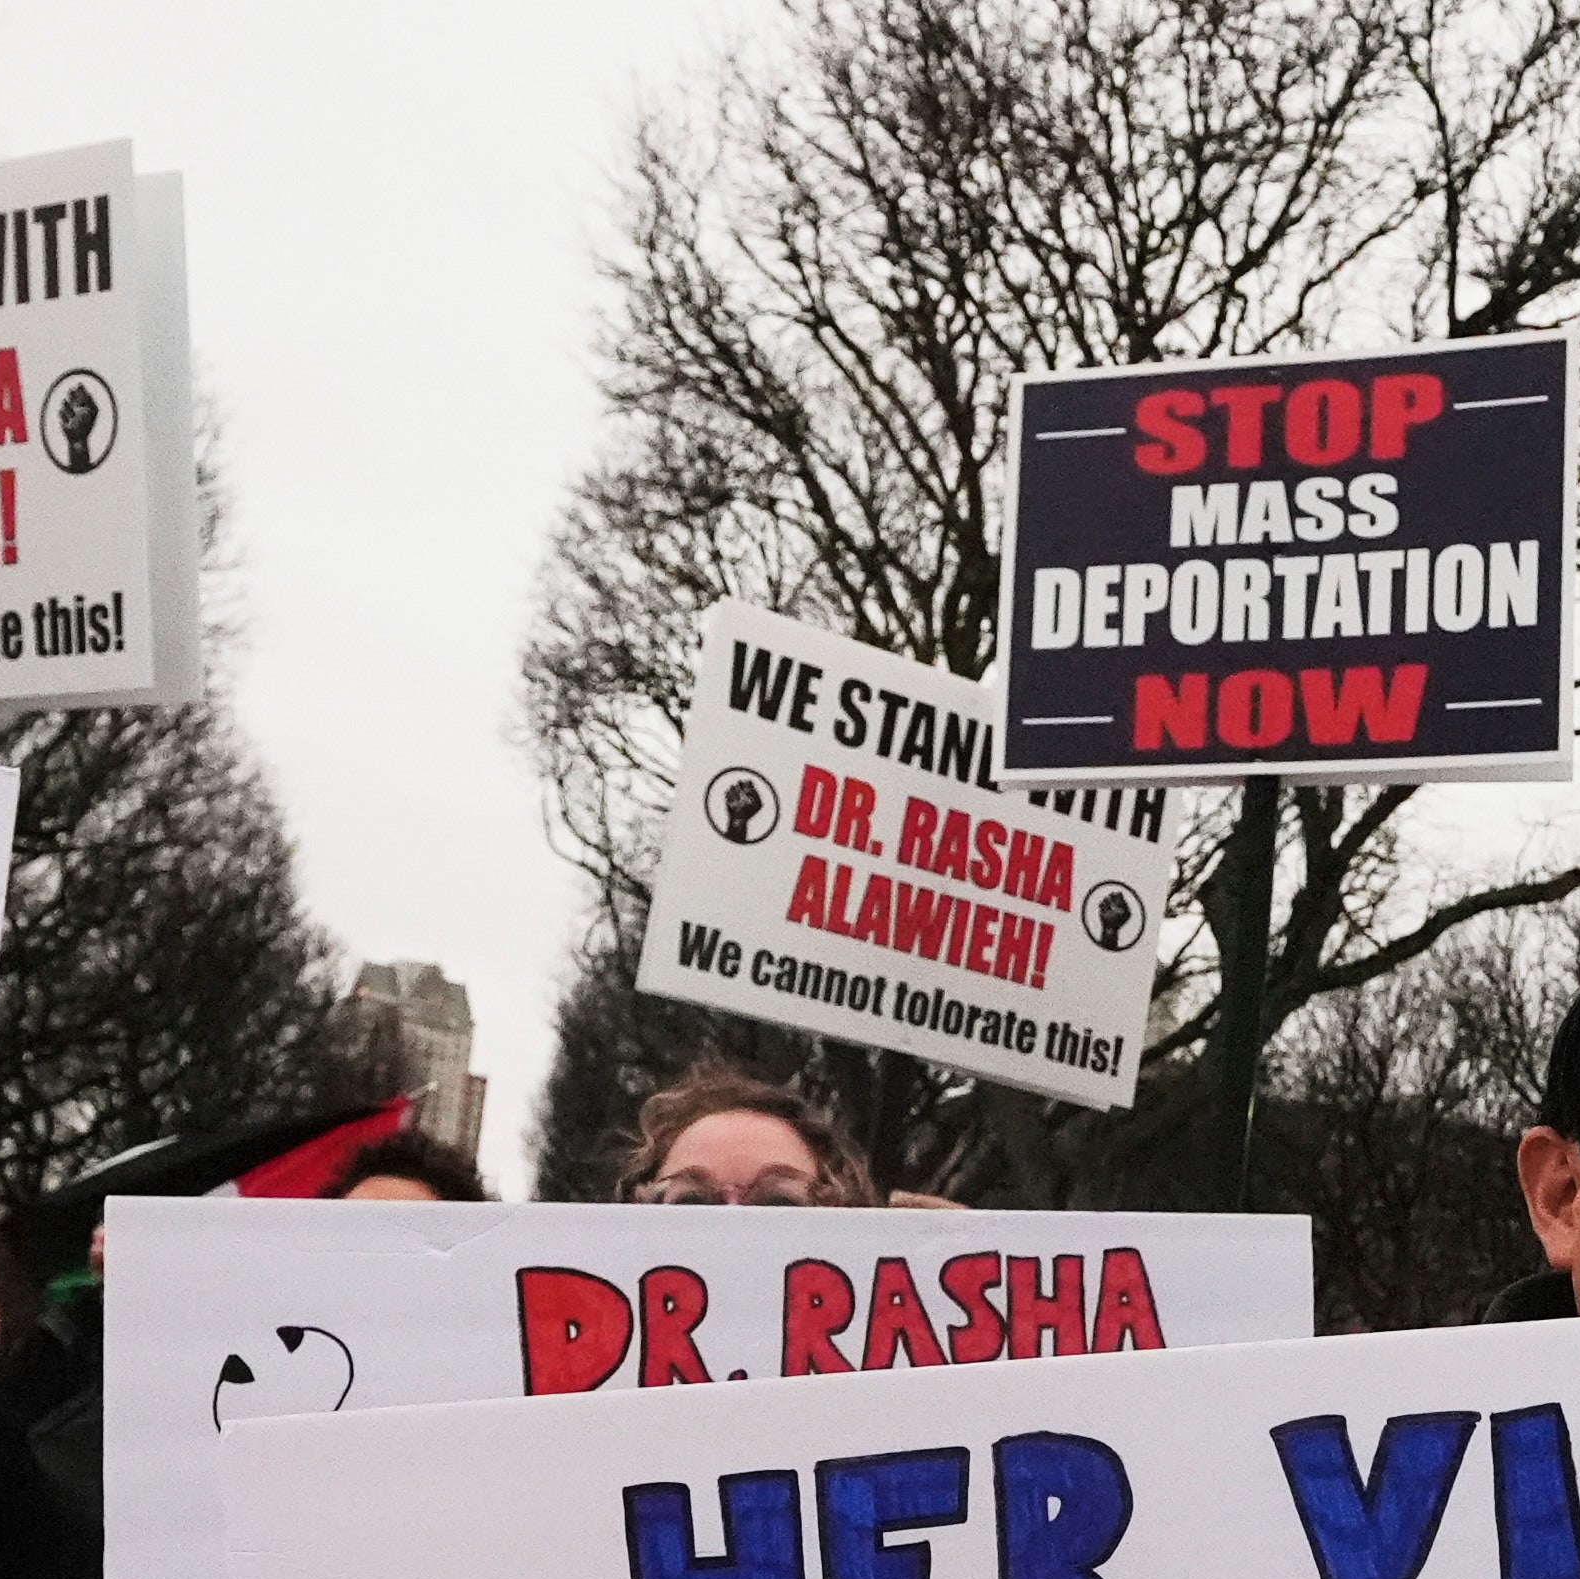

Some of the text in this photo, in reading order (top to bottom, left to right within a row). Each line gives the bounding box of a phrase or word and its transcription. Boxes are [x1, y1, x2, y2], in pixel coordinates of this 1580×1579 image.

[1134, 372, 1443, 476] STOP
[1170, 474, 1399, 548] MASS
[33, 592, 124, 658] this!
[1032, 540, 1539, 650] DEPORTATION
[728, 640, 822, 733] WE
[1134, 663, 1428, 753] NOW
[792, 763, 884, 859] DR.
[899, 798, 1074, 914] RASHA
[787, 855, 1055, 989] ALAWIEH!
[678, 921, 1122, 1077] We cannot tolorate this!
[780, 1247, 1167, 1378] RASHA
